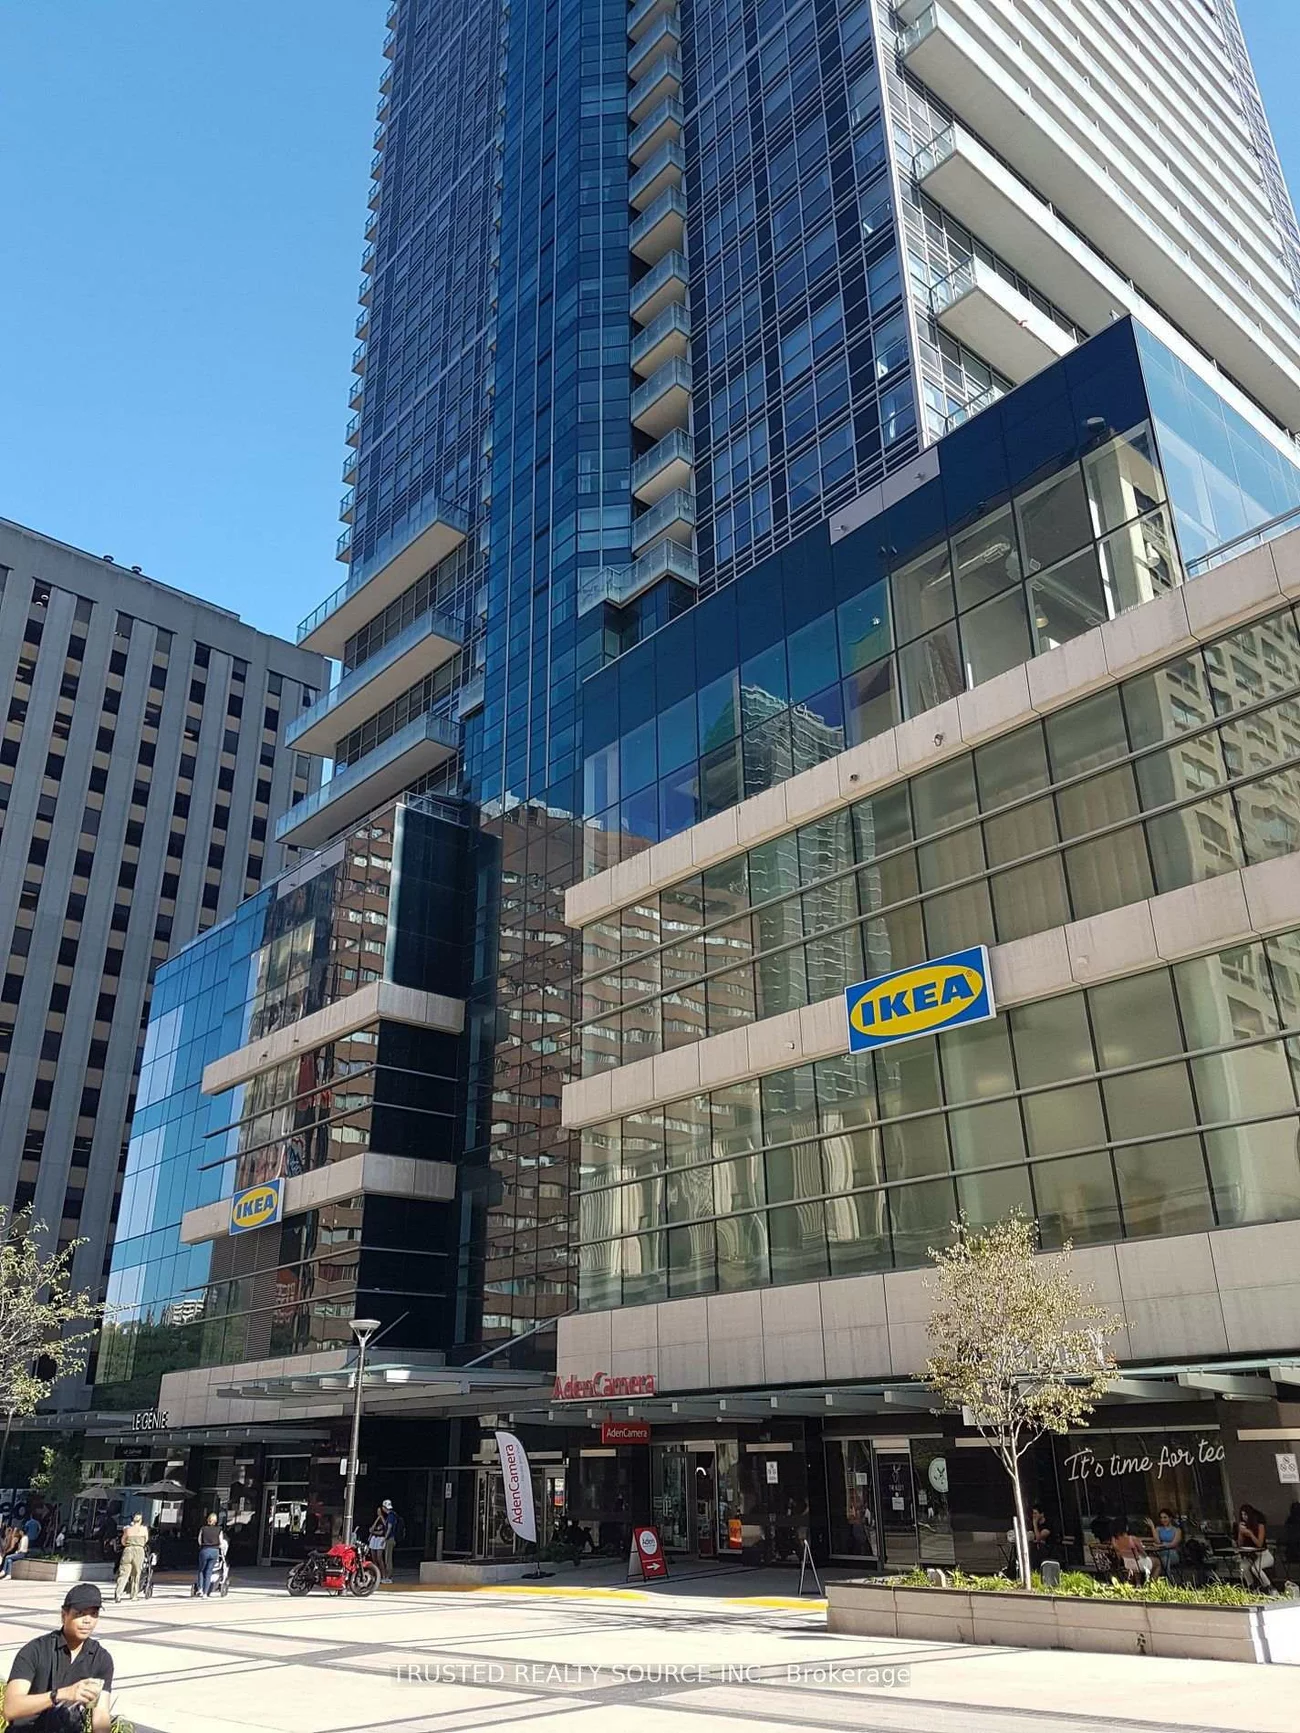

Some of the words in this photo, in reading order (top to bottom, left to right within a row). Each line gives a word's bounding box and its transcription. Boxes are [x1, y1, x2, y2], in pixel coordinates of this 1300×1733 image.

[861, 972, 975, 1028] IKEA
[236, 1193, 275, 1220] IKEA
[552, 1371, 657, 1399] AdenCamera
[132, 1413, 140, 1431] LE
[141, 1407, 168, 1430] GÉNIE
[606, 1427, 648, 1438] AdenCamera
[1064, 1448, 1104, 1481] It's
[1110, 1453, 1154, 1477] time
[1158, 1445, 1195, 1480] for
[1198, 1438, 1226, 1464] tea
[505, 1443, 523, 1525] AdenCamera
